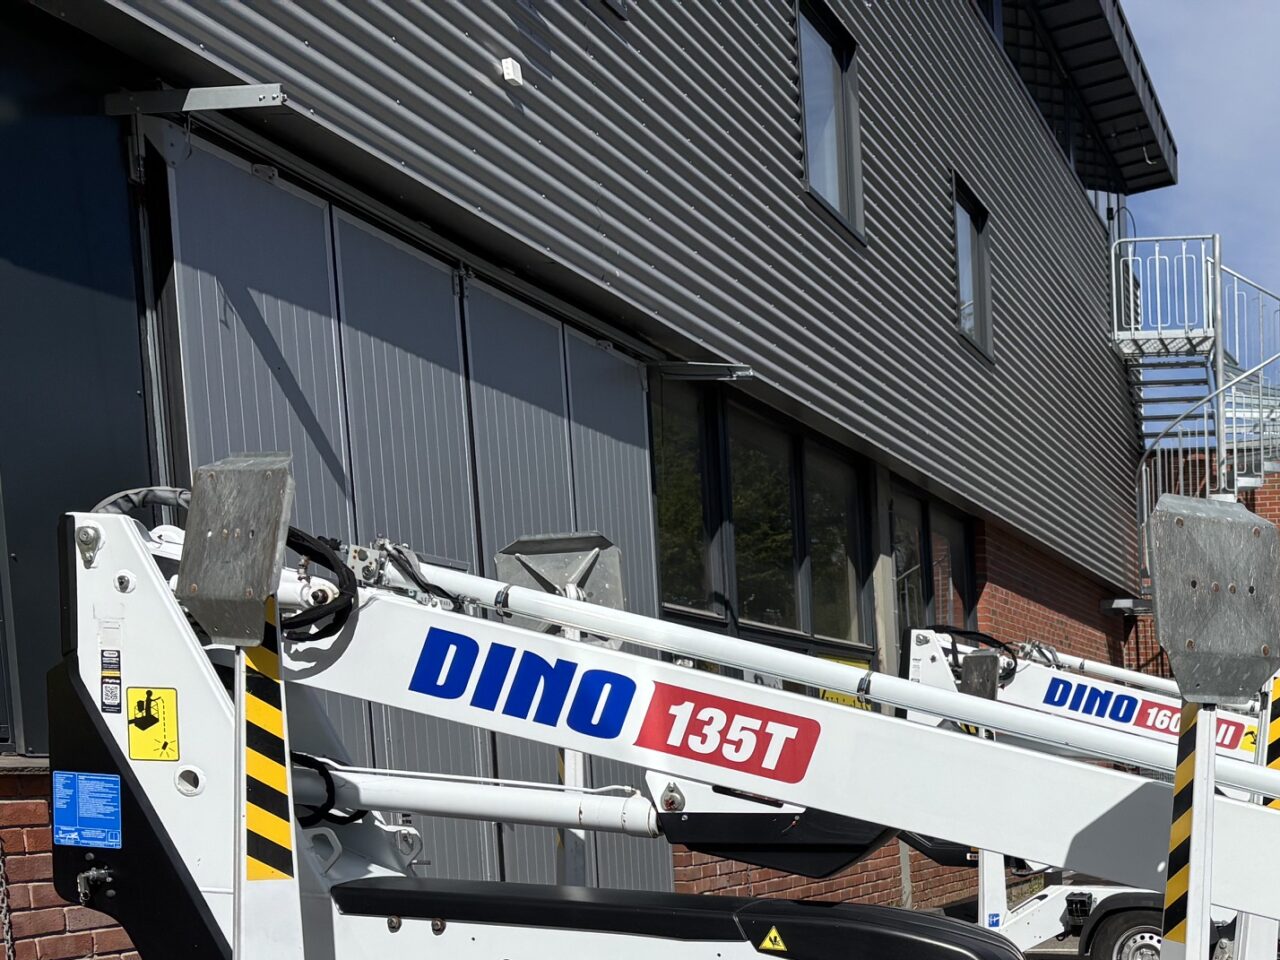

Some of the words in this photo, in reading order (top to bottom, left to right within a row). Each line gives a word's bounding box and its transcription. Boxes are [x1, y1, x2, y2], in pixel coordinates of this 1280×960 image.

[408, 626, 637, 740] DINO
[666, 701, 799, 770] 135T
[1043, 677, 1139, 724] DINO
